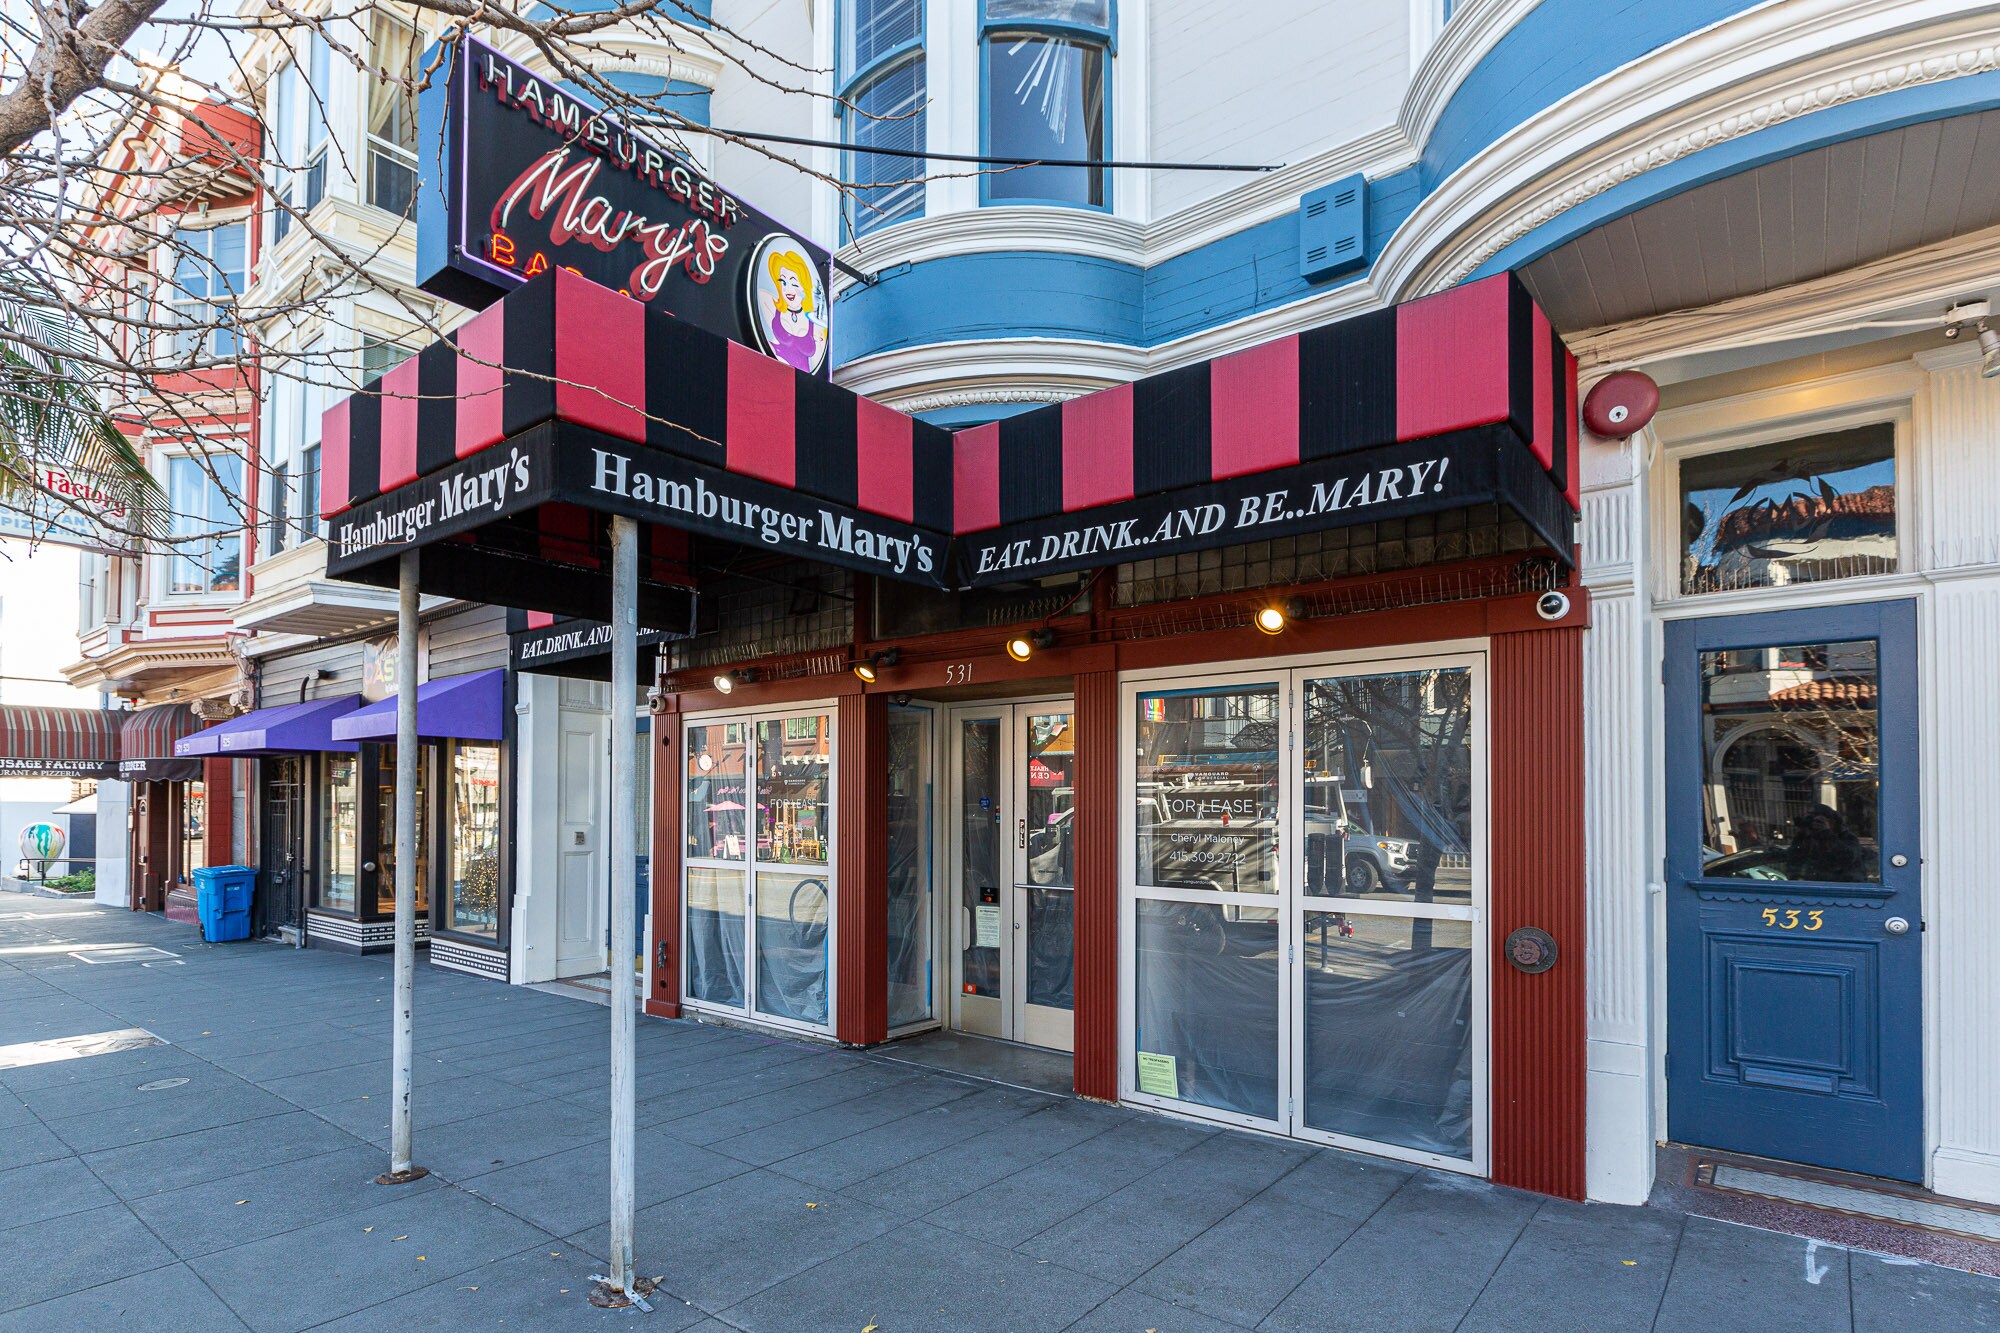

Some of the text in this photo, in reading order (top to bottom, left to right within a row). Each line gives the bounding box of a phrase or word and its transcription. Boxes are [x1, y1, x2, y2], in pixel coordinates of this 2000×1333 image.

[482, 54, 738, 228] HAMBURGER
[491, 147, 730, 301] Mary's
[487, 232, 583, 277] BA
[45, 469, 126, 517] Factory
[338, 447, 530, 558] Hamburger Mary's
[590, 448, 934, 574] Hamburger Mary's
[945, 662, 973, 685] 531
[45, 760, 105, 769] FACTORY
[1163, 799, 1254, 813] FOR LEASE
[1170, 833, 1245, 846] Cheryl Maloney
[1169, 850, 1247, 865] 415.309.2722
[1761, 907, 1825, 931] 533
